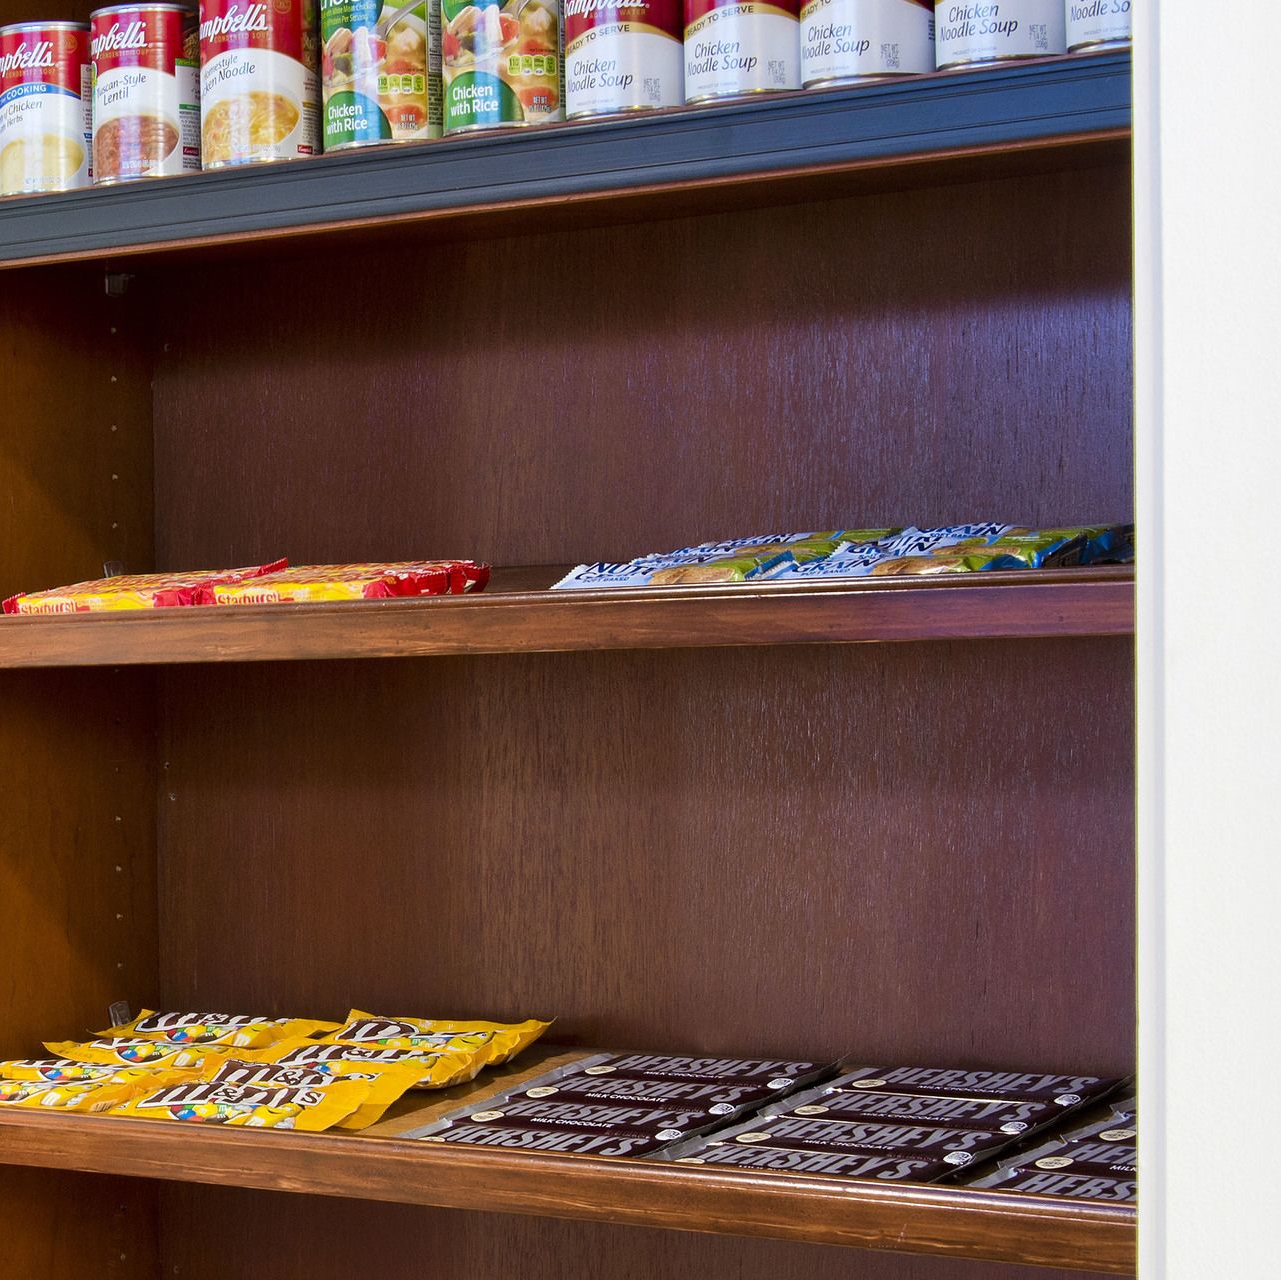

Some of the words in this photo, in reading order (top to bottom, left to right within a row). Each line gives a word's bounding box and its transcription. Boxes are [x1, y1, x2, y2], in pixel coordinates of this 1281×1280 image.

[949, 3, 999, 20] Chicken
[940, 20, 978, 41] Noodle
[980, 19, 1018, 37] Soup
[688, 58, 720, 77] Noodle
[721, 55, 757, 73] Soup
[6, 84, 47, 100] COOKING
[97, 73, 146, 98] Tuscan-Style
[453, 83, 493, 102] Chicken
[103, 87, 129, 106] Lentil
[328, 102, 363, 119] Chicken
[450, 104, 470, 115] with
[473, 98, 498, 113] Rice
[327, 122, 344, 132] with
[345, 117, 367, 131] Rice
[618, 1054, 813, 1079] HERSHEY'S
[558, 1076, 755, 1103] HERSHEY'S
[882, 1067, 1099, 1094] HERSHEY'S
